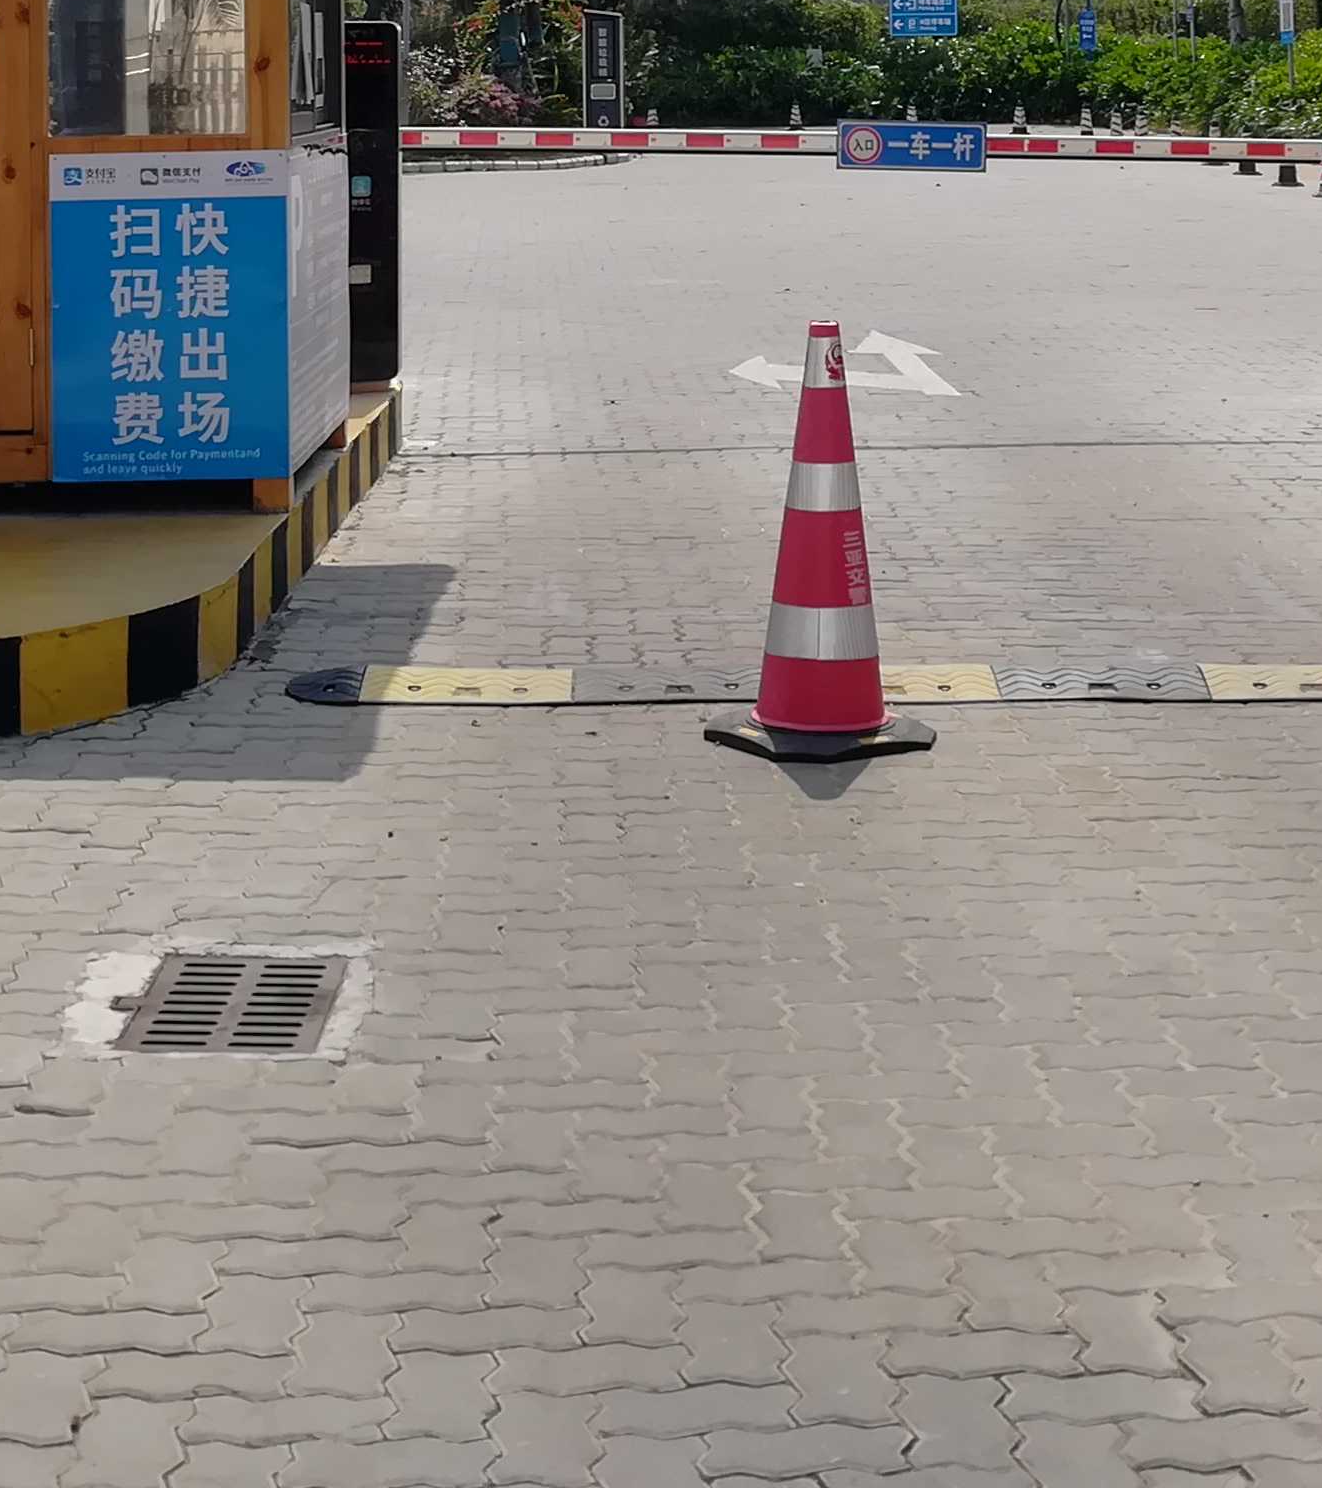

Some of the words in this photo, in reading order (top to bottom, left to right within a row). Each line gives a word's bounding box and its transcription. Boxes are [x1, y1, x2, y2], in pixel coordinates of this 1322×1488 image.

[853, 138, 874, 152] 入口
[887, 130, 975, 162] 一车一杆
[85, 167, 116, 179] 支付宝
[162, 167, 201, 177] 微信支付
[109, 203, 165, 446] 扫码缴费
[175, 202, 230, 444] 快捷出场
[83, 451, 135, 463] Scanning
[138, 450, 168, 460] Code
[171, 449, 187, 460] for
[83, 464, 104, 474] and
[107, 463, 137, 474] leave
[140, 462, 183, 475] quickly
